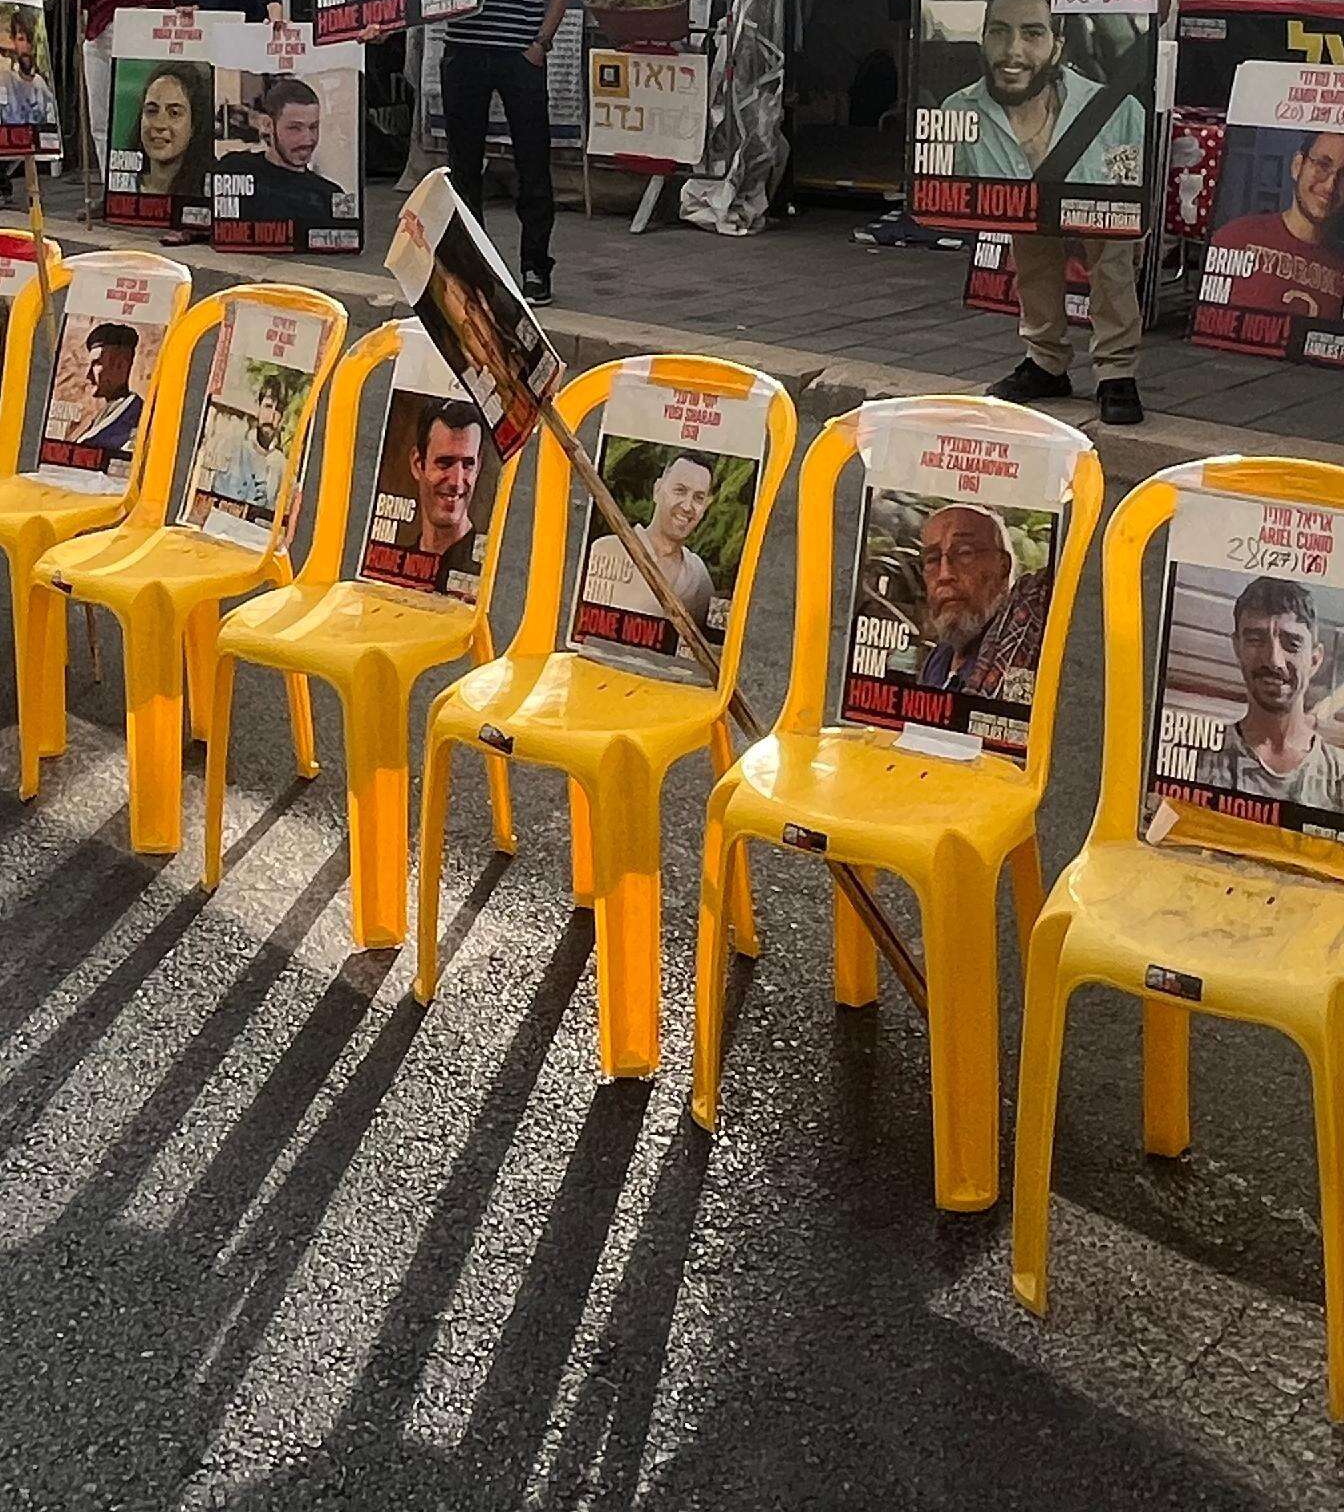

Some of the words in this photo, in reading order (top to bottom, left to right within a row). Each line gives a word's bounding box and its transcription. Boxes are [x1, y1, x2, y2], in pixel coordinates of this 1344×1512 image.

[318, 3, 360, 34] HOME
[916, 108, 979, 142] BRING
[914, 142, 954, 175] HIM
[214, 174, 254, 196] BRING
[914, 180, 971, 212] HOME
[977, 182, 1037, 220] NOW!
[1205, 245, 1254, 277] BRING
[1198, 274, 1232, 304] HIM
[1194, 306, 1242, 337] HOME
[1242, 313, 1291, 345] NOW!
[376, 493, 416, 522] BRING
[371, 517, 397, 544] HIM
[580, 606, 619, 639] HOME
[621, 614, 665, 649] NOW!
[856, 615, 910, 651] BRING
[852, 644, 888, 678] HIM
[849, 678, 898, 714] HOME
[902, 689, 953, 725] NOW!
[1161, 710, 1224, 752] BRING
[1156, 744, 1198, 781] HIM
